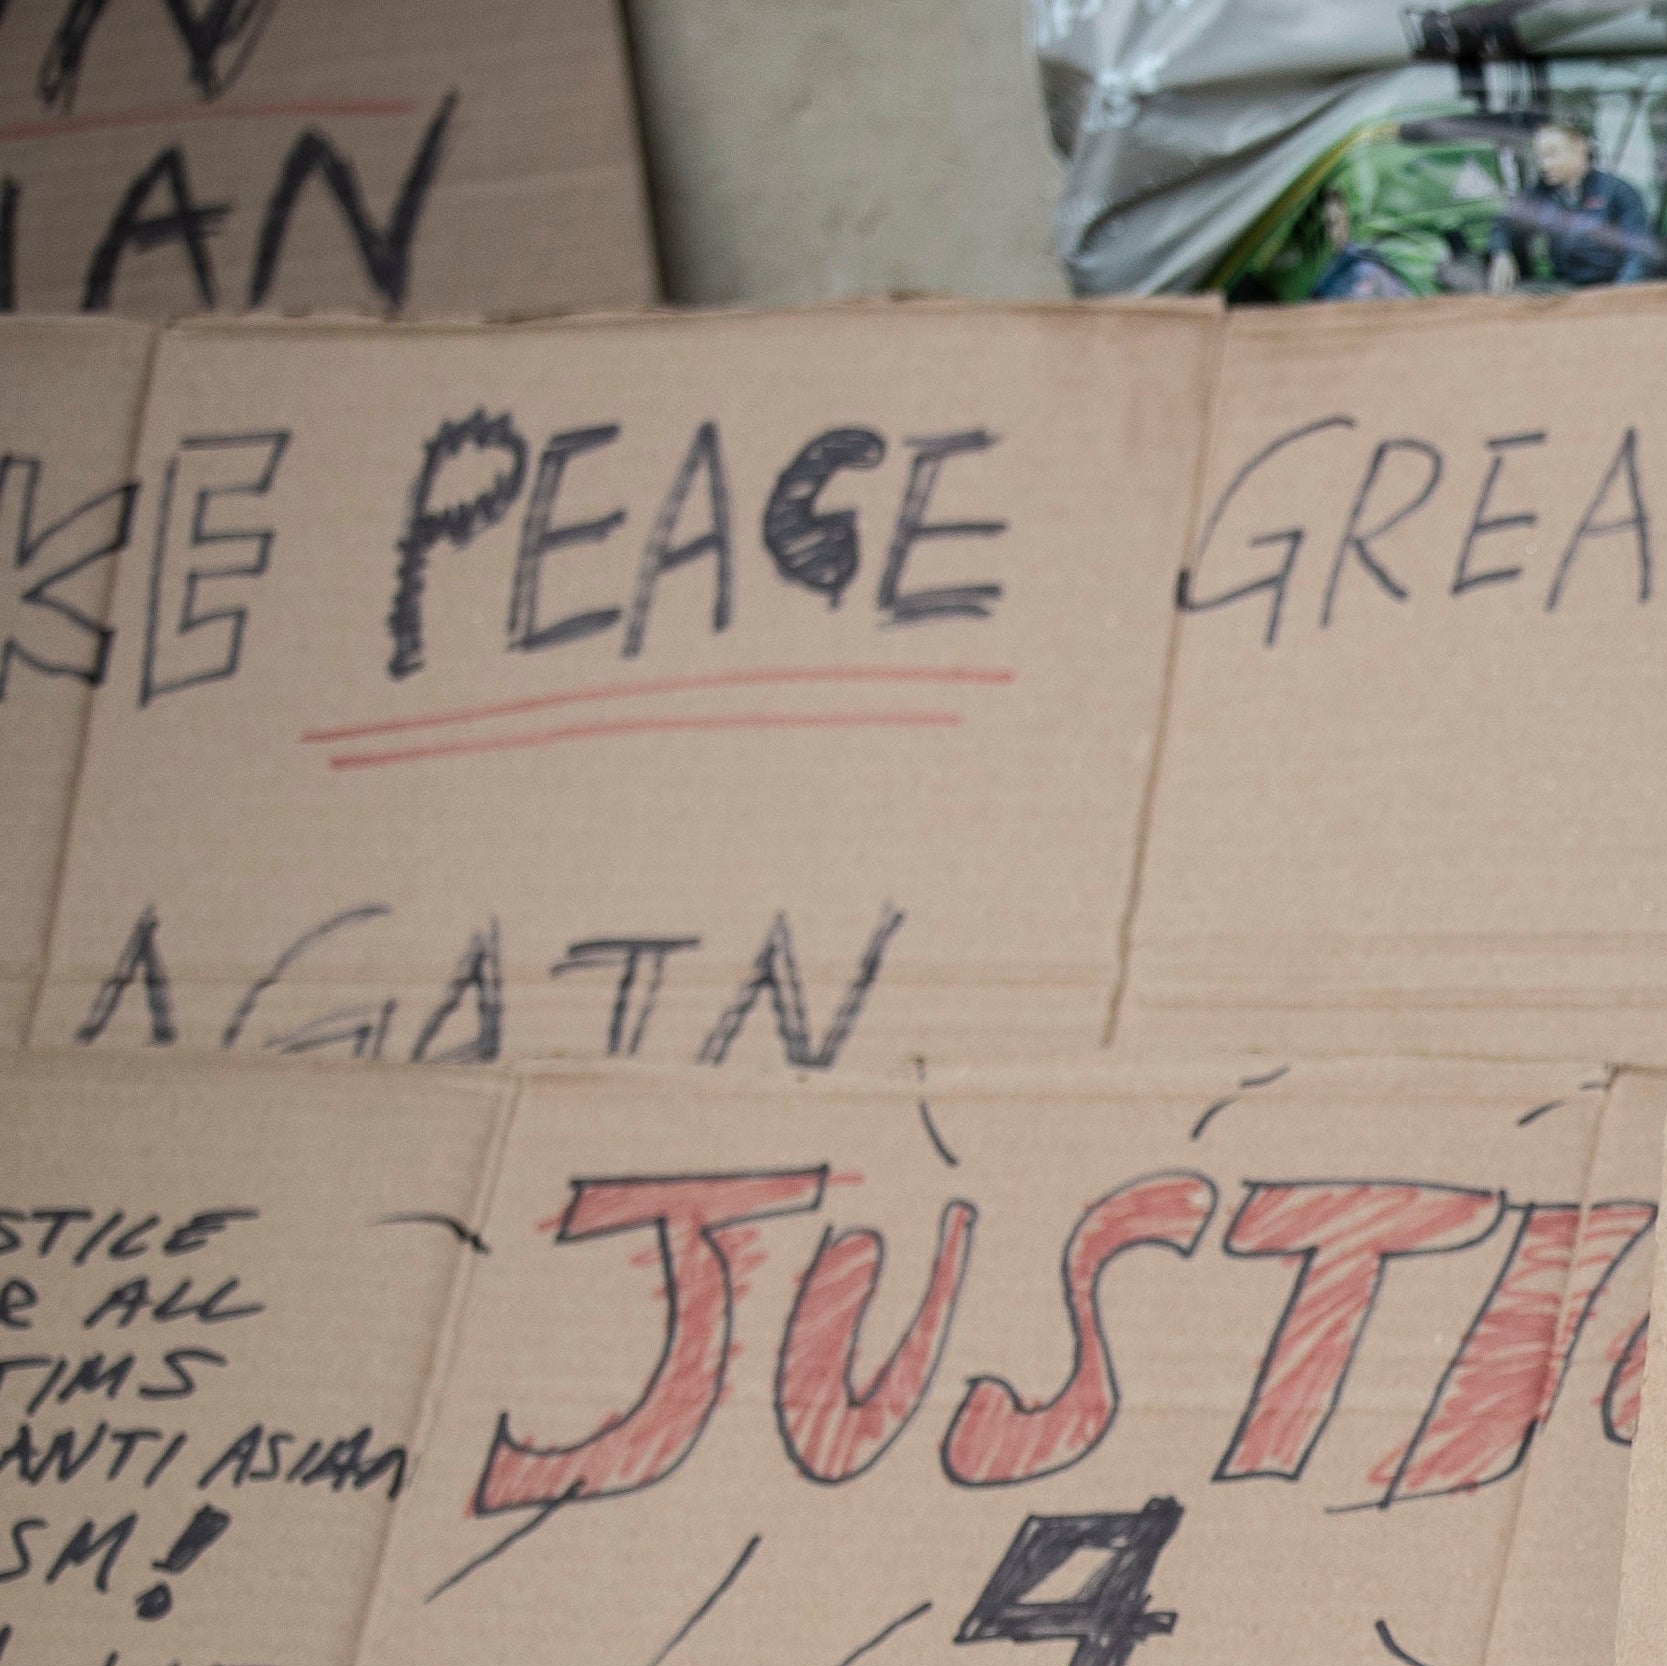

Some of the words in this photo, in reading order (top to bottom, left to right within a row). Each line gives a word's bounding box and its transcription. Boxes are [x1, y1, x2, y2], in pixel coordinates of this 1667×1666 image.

[83, 1275, 265, 1330] ALL
[462, 1164, 1658, 1516] JUSTI
[198, 1422, 407, 1501] ASIAN
